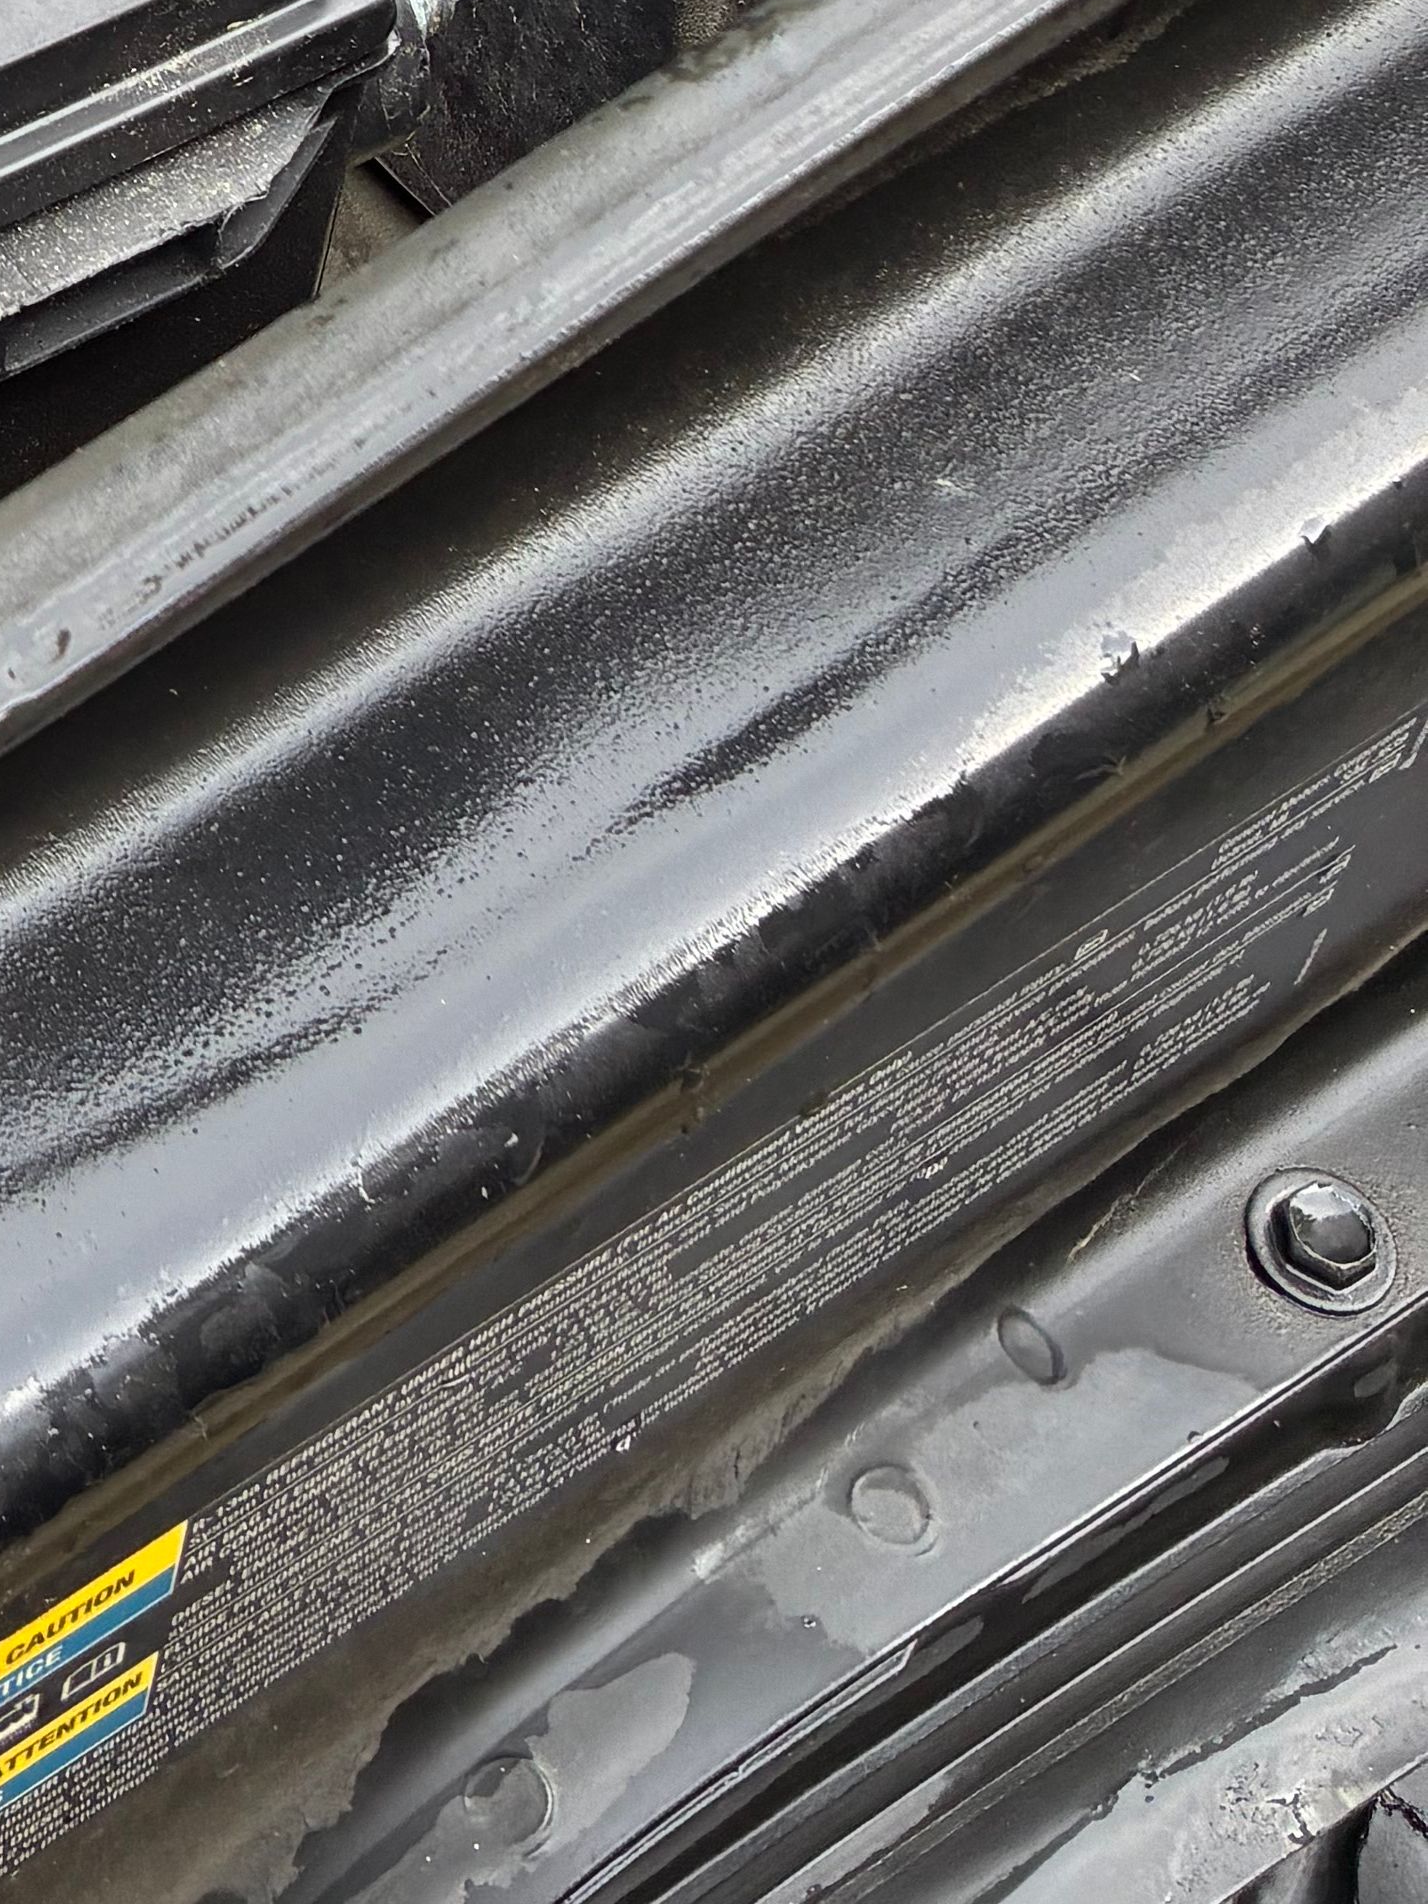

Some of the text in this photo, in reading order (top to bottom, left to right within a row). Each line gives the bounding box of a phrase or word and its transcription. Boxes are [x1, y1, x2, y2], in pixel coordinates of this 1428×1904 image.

[265, 1390, 397, 1485] REFRIGERANT
[468, 1312, 513, 1350] HIGH
[517, 1247, 611, 1317] PRESSURE
[5, 1569, 135, 1665] CAUTION
